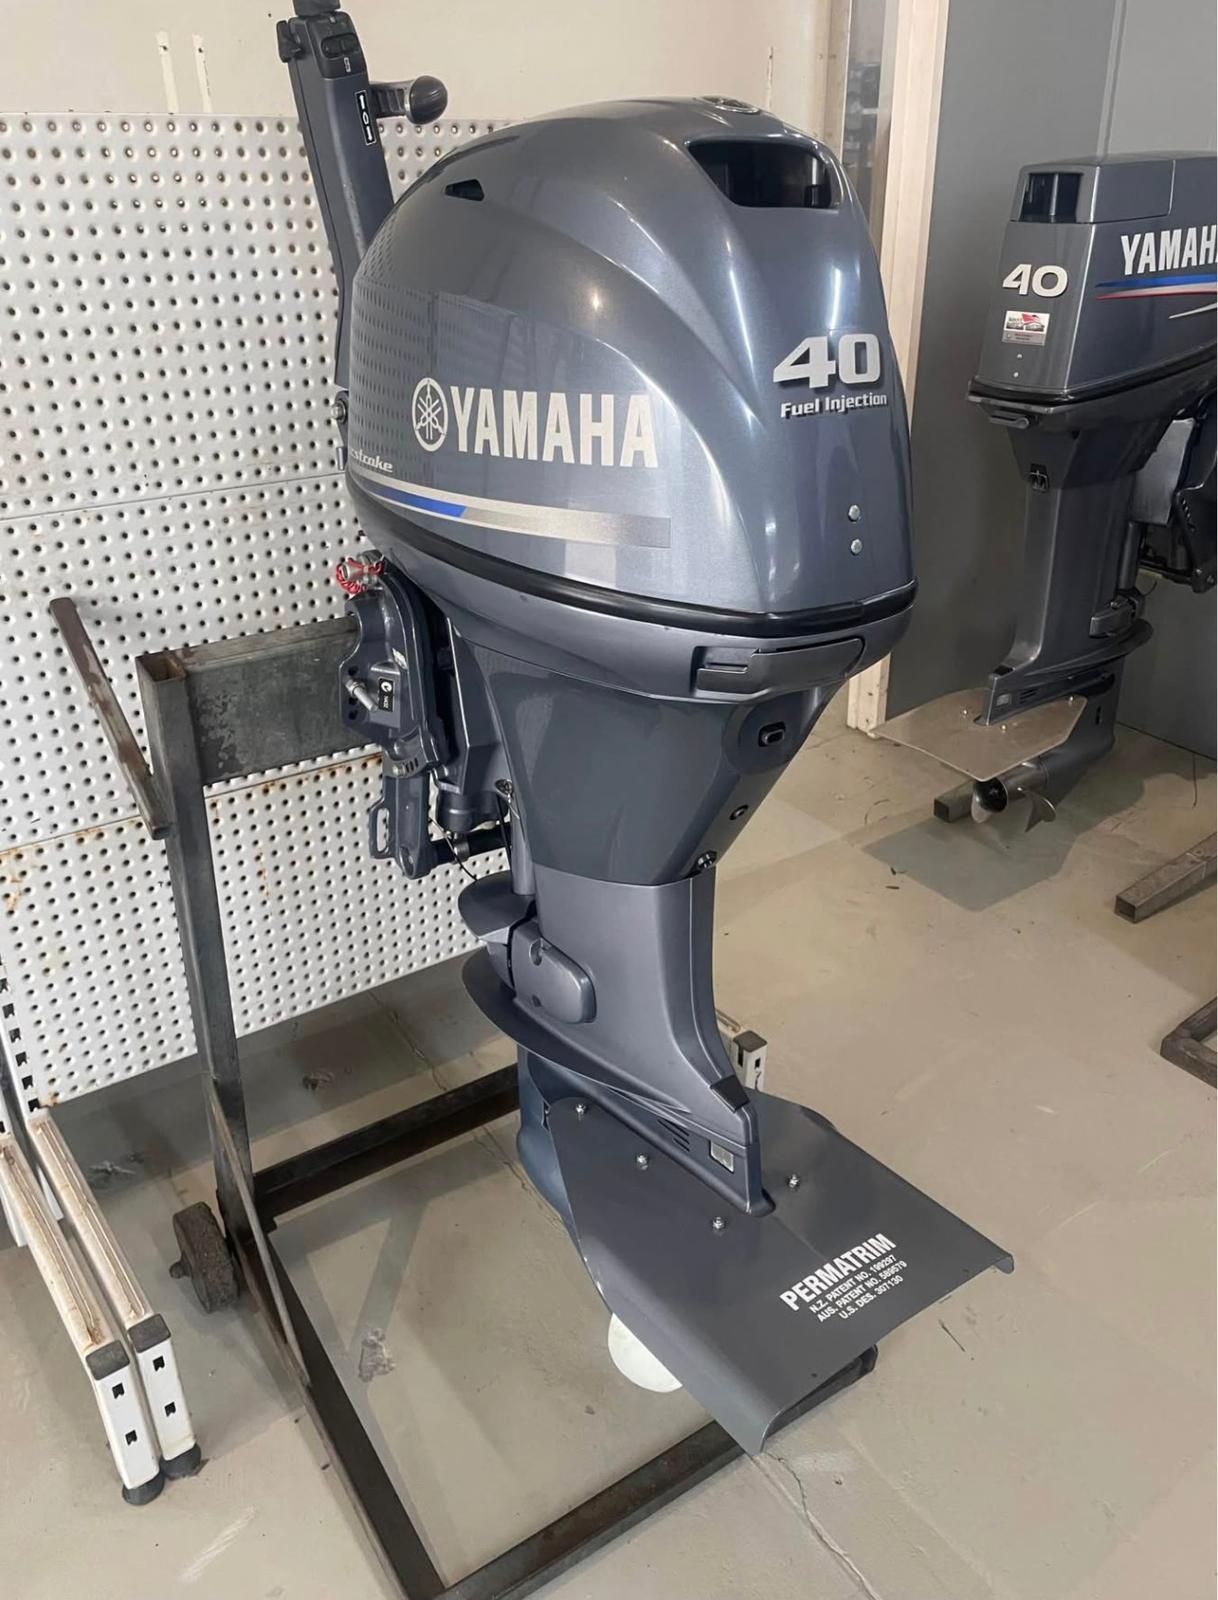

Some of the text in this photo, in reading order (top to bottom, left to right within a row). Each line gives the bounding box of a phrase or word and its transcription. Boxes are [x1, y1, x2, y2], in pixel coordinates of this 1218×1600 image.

[1120, 225, 1217, 275] YAMAH
[1002, 263, 1068, 298] 40
[772, 333, 881, 389] 40
[450, 386, 659, 468] YAMAHA
[781, 392, 888, 418] Fuel Injection
[779, 1233, 897, 1311] PERMATRIM
[809, 1299, 829, 1313] N.Z.
[826, 1279, 857, 1301] PATENT
[854, 1270, 872, 1283] NO.
[816, 1304, 839, 1323] AUS.
[835, 1285, 867, 1309] PATENT
[864, 1276, 882, 1290] NO.
[838, 1275, 904, 1320] U.S. DES. 307130
